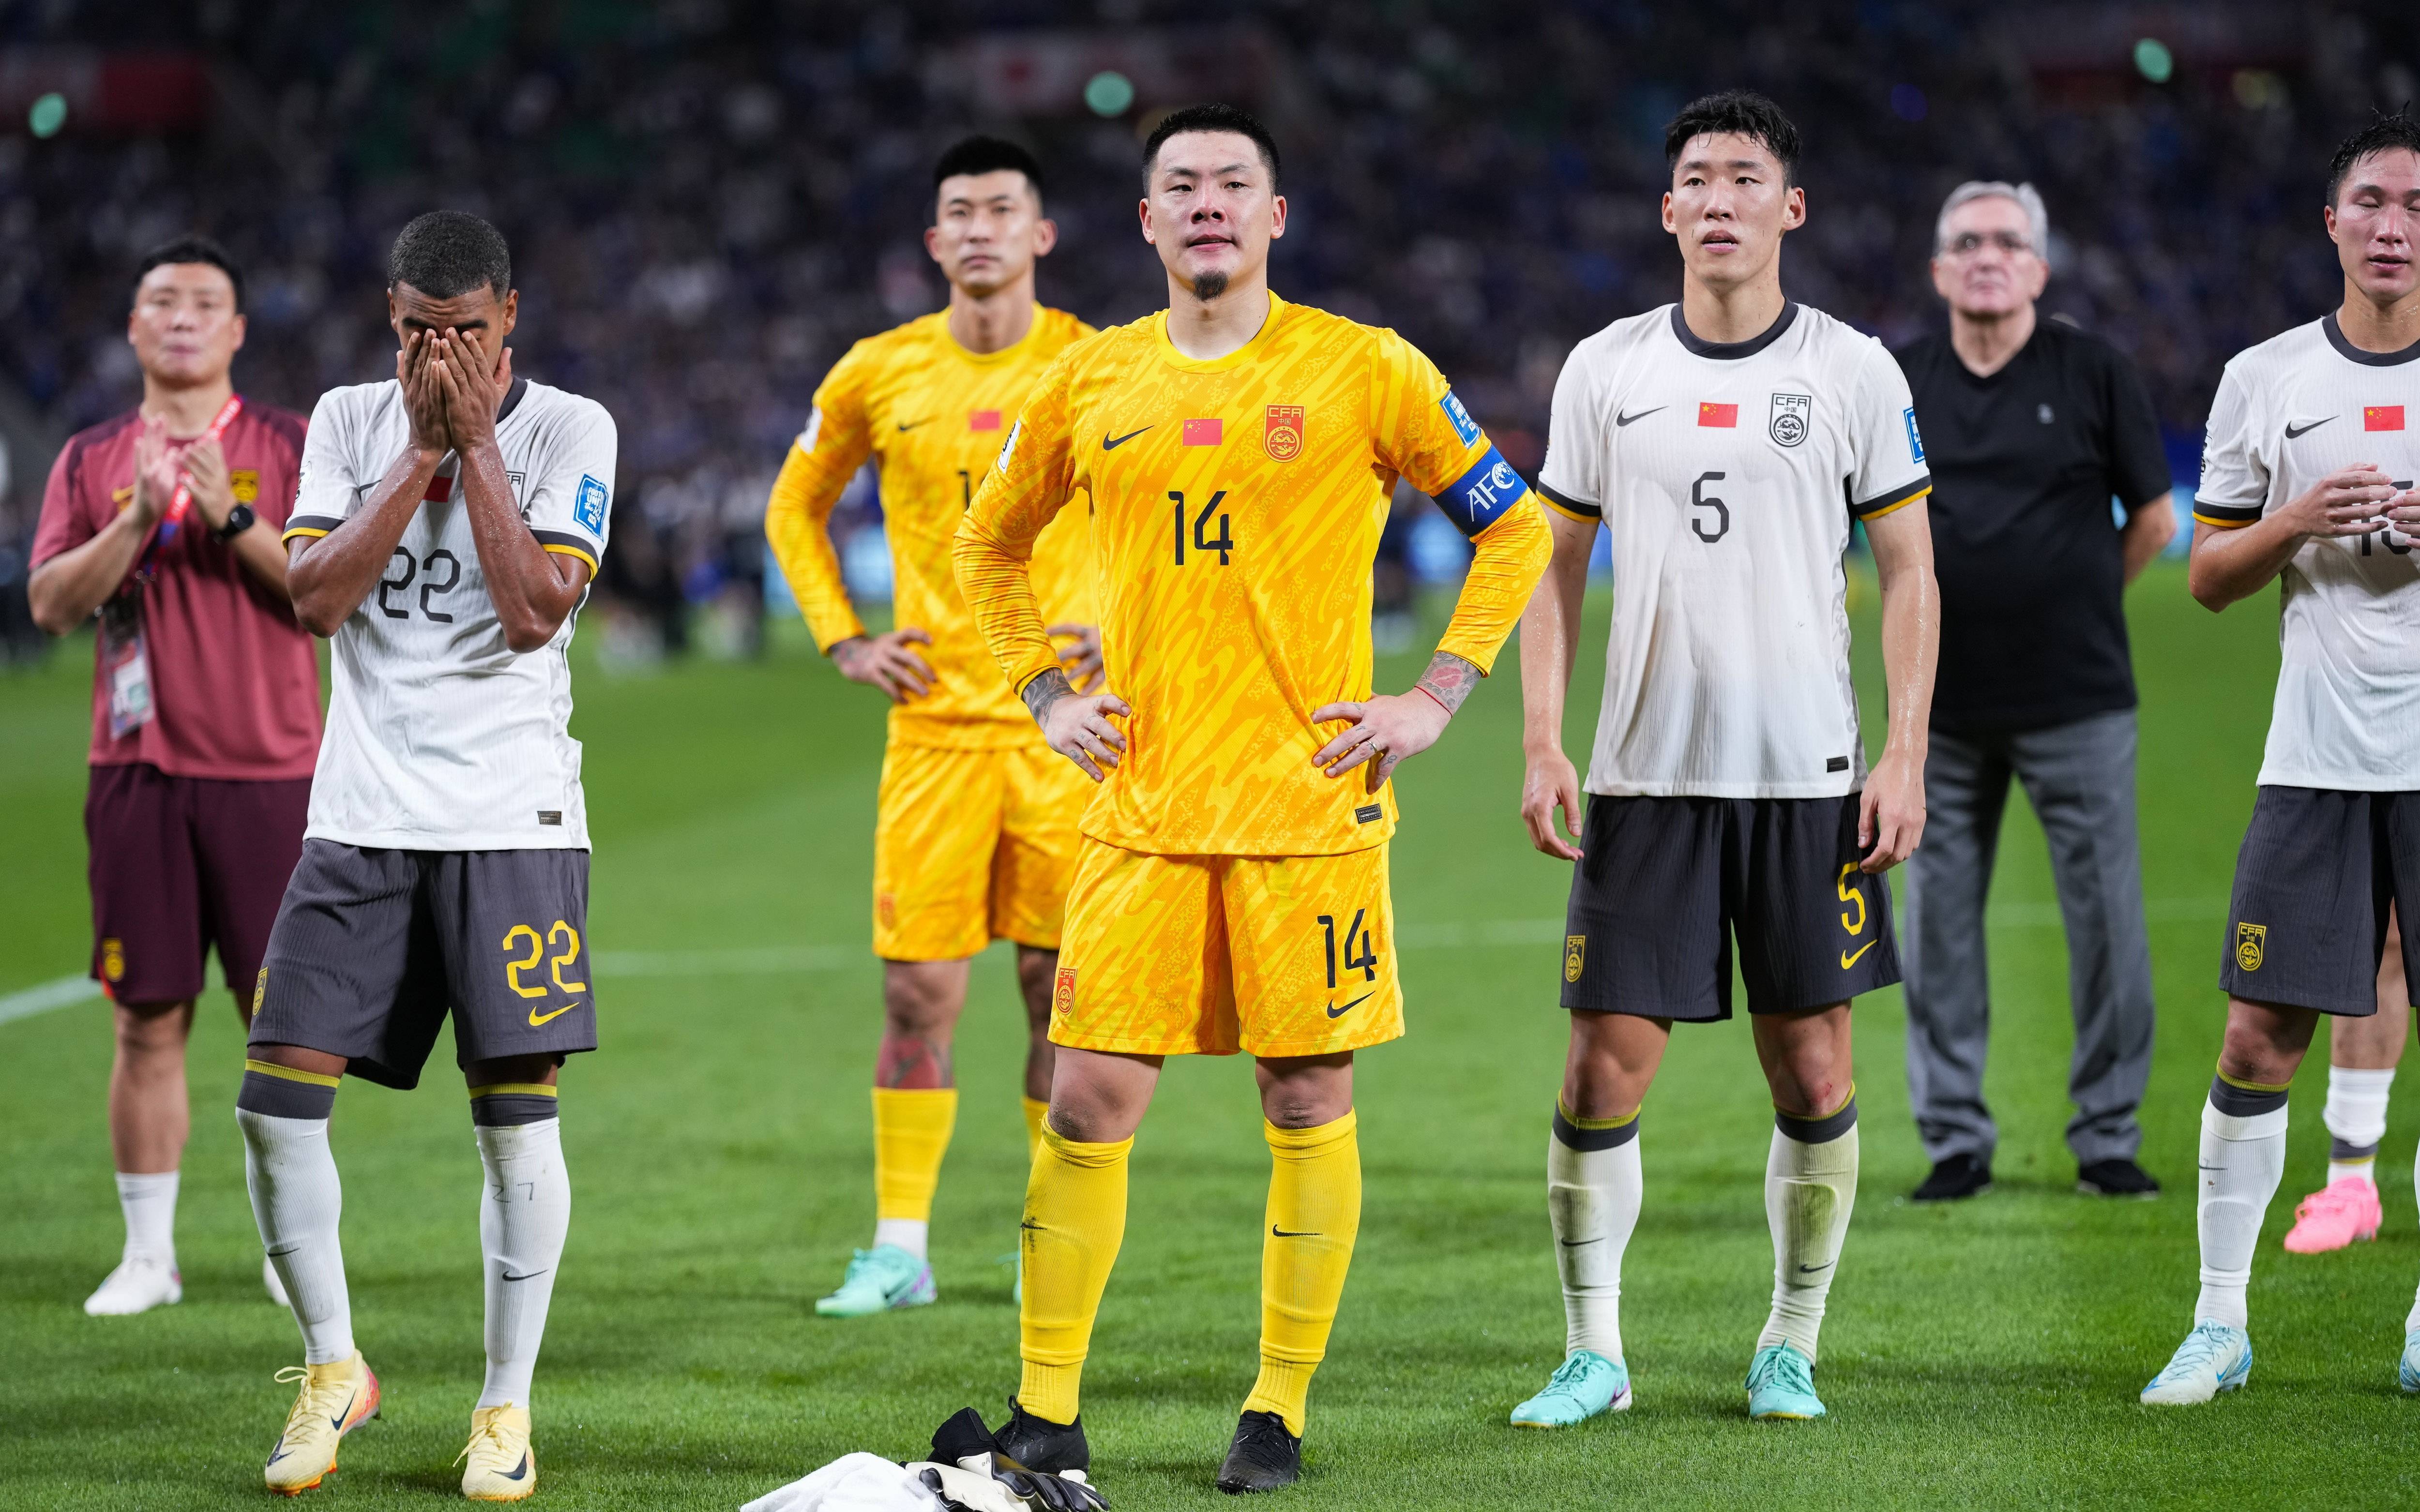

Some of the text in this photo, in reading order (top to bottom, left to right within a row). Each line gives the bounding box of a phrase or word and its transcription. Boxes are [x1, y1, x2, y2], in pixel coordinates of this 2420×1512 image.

[1269, 407, 1302, 418] CFA
[1775, 397, 1807, 406] CFA
[1466, 460, 1514, 522] AFC
[1692, 472, 1729, 543] 5
[1168, 491, 1234, 566] 14
[378, 546, 461, 623] 22
[1838, 861, 1866, 936] 5
[502, 920, 586, 999] 22
[1317, 908, 1377, 988] 14
[1568, 939, 1583, 948] CFA
[2240, 925, 2263, 938] CFA
[1059, 969, 1075, 979] CFA
[492, 1182, 534, 1203] 27
